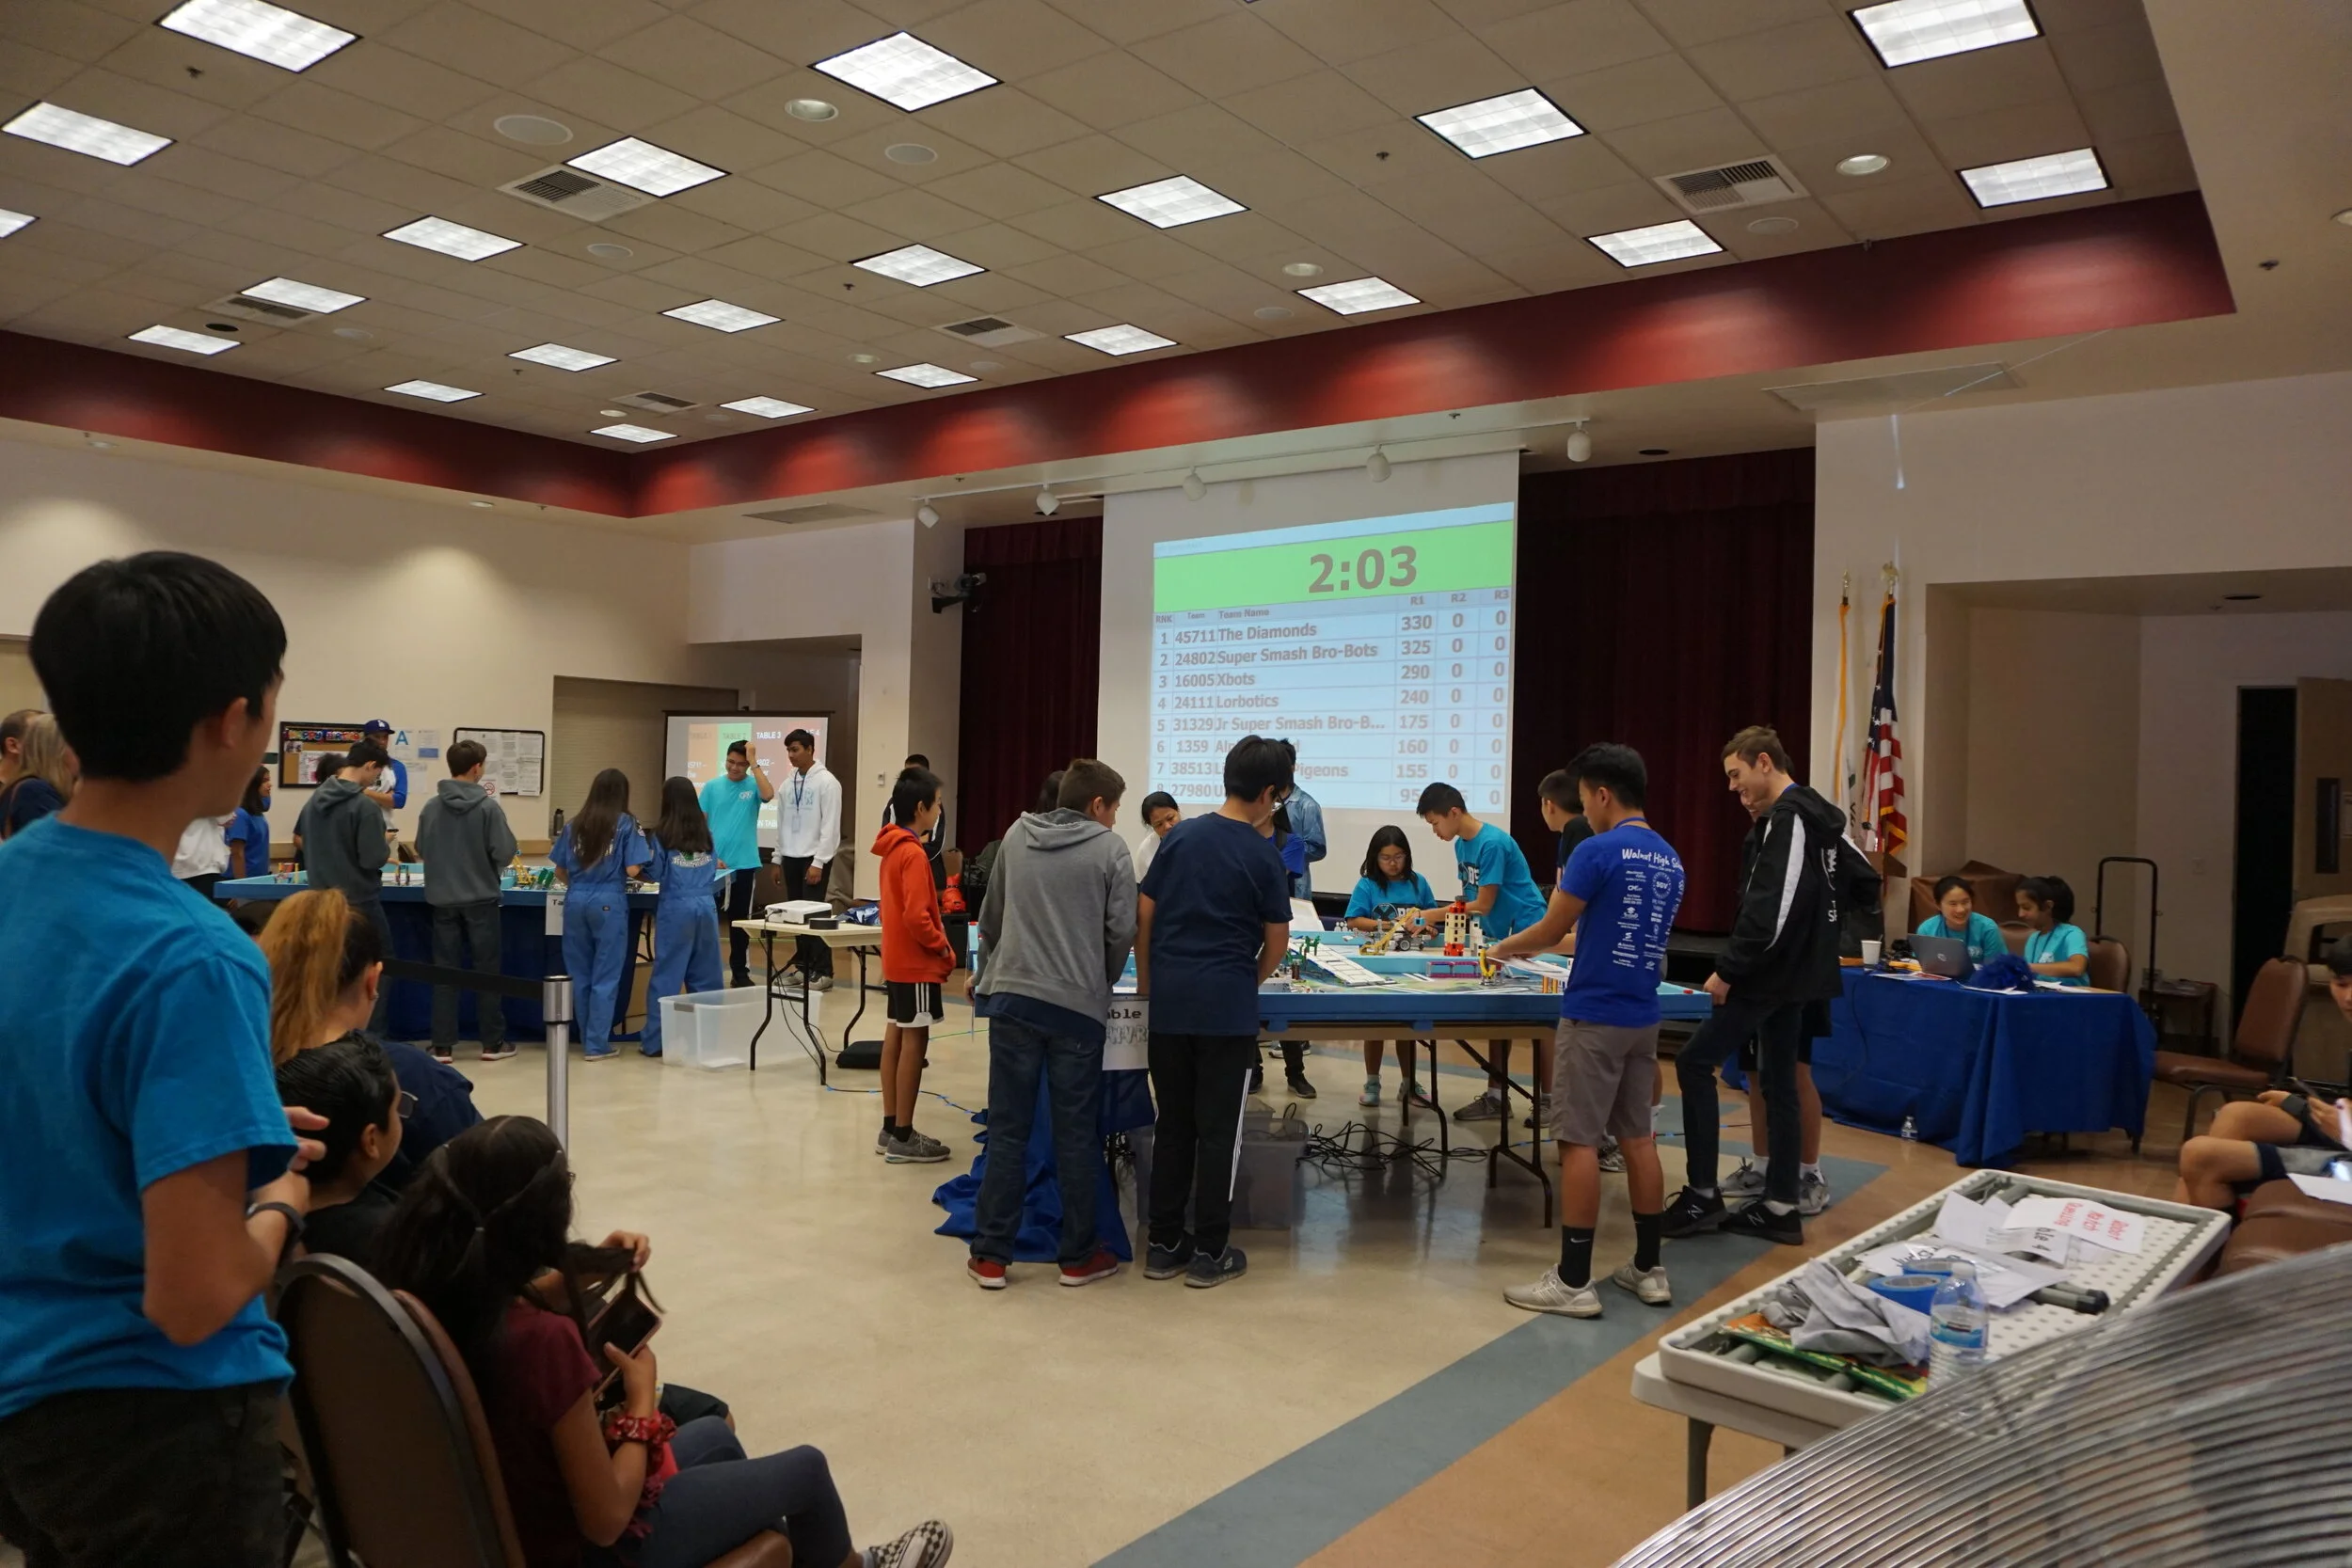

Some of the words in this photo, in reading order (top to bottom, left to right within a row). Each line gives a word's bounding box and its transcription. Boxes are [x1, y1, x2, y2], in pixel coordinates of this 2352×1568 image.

[1309, 546, 1417, 594] 2:03
[1155, 614, 1172, 624] RNK
[1218, 610, 1242, 619] Team
[1244, 610, 1270, 618] Name
[1410, 595, 1425, 606] R1
[1451, 594, 1467, 604] R2
[1494, 590, 1510, 600] R3
[1161, 632, 1168, 644] 1
[1175, 629, 1216, 644] 45711
[1217, 628, 1243, 641] The
[1247, 623, 1317, 641] Diamonds
[1401, 615, 1432, 631] 330
[1452, 612, 1464, 627] 0
[1495, 610, 1506, 626] 0
[1160, 653, 1168, 666] 2
[1175, 651, 1216, 666] 24802
[1216, 650, 1257, 666] Super
[1261, 646, 1308, 661] Smash
[1311, 642, 1378, 659] Bro-Bots
[1401, 640, 1431, 655] 325
[1452, 638, 1463, 653] 0
[1494, 636, 1505, 651] 0
[1158, 675, 1168, 689] 3
[1174, 673, 1215, 688] 16005
[1216, 673, 1255, 686] Xbots
[1400, 664, 1430, 679] 290
[1451, 663, 1462, 678] 0
[1494, 661, 1505, 676] 0
[1158, 697, 1167, 709] 4
[1174, 695, 1214, 709] 24111
[1216, 693, 1279, 708] Lorbotics
[1400, 689, 1429, 705] 240
[1451, 689, 1461, 703] 0
[1493, 688, 1503, 703] 0
[1157, 719, 1165, 732] 5
[1173, 717, 1214, 731] 31329
[1216, 718, 1229, 730] Jr
[1232, 716, 1271, 732] Super
[1275, 715, 1323, 730] Smash
[1327, 715, 1385, 729] Bro-B...
[1399, 715, 1428, 729] 175
[1450, 714, 1460, 728] 0
[1492, 713, 1502, 728] 0
[395, 730, 409, 746] A
[1157, 740, 1165, 752] 6
[1177, 740, 1209, 752] 1359
[1397, 738, 1427, 753] 160
[1449, 738, 1459, 753] 0
[1491, 738, 1502, 753] 0
[1157, 763, 1165, 774] 7
[1171, 762, 1213, 775] 38513
[1396, 764, 1427, 779] 155
[1448, 764, 1458, 779] 0
[1490, 764, 1502, 779] 0
[1171, 784, 1212, 798] 27980
[1489, 790, 1501, 805] 0
[1622, 848, 1652, 862] Walnut
[1653, 852, 1670, 867] High
[1107, 1008, 1142, 1020] ble
[2033, 1227, 2057, 1242] ble
